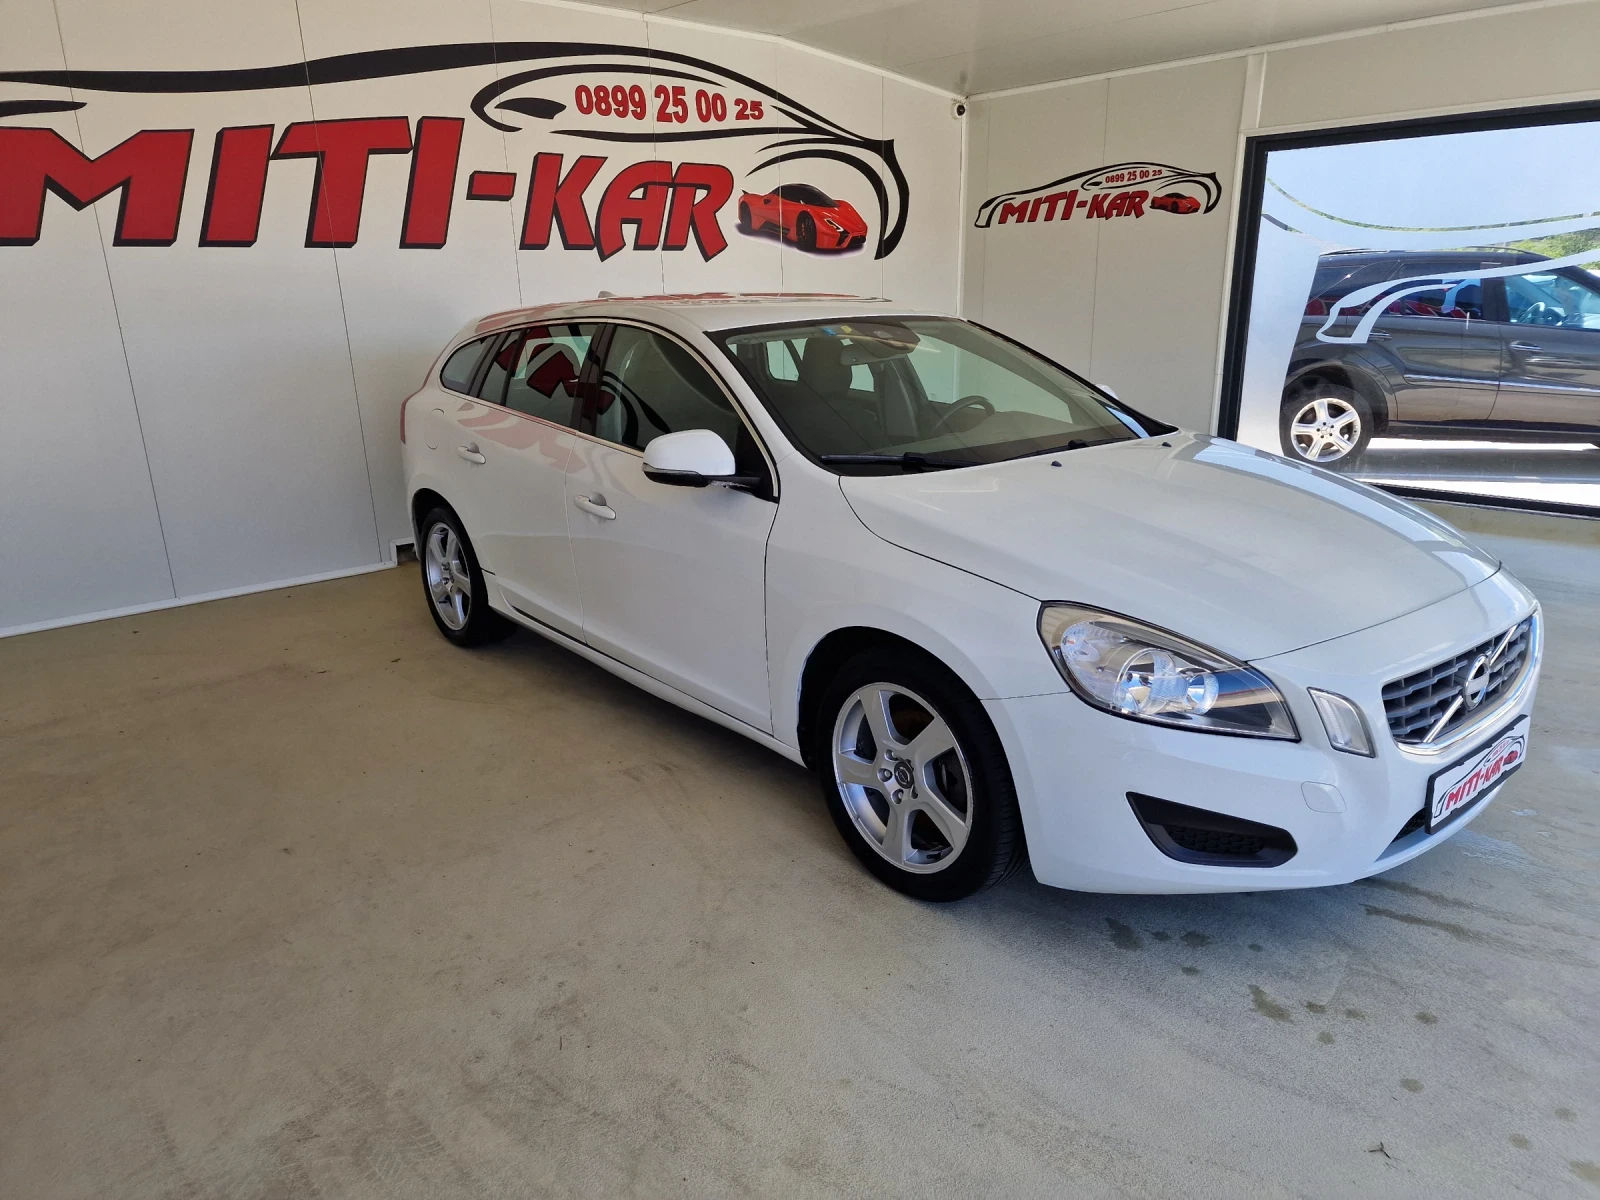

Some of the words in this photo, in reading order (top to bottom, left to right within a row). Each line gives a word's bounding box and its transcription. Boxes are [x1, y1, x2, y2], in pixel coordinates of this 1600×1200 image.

[575, 84, 647, 121] 0899
[655, 84, 689, 124] 25
[695, 89, 728, 123] 00
[734, 98, 764, 120] 25
[0, 115, 734, 263] MITI-KAR
[1105, 174, 1125, 184] 0899
[1127, 171, 1137, 182] 25
[1139, 170, 1150, 179] 00
[1152, 169, 1163, 177] 25
[998, 190, 1150, 225] MITI-KAR
[1445, 756, 1504, 811] MITI-KAR
